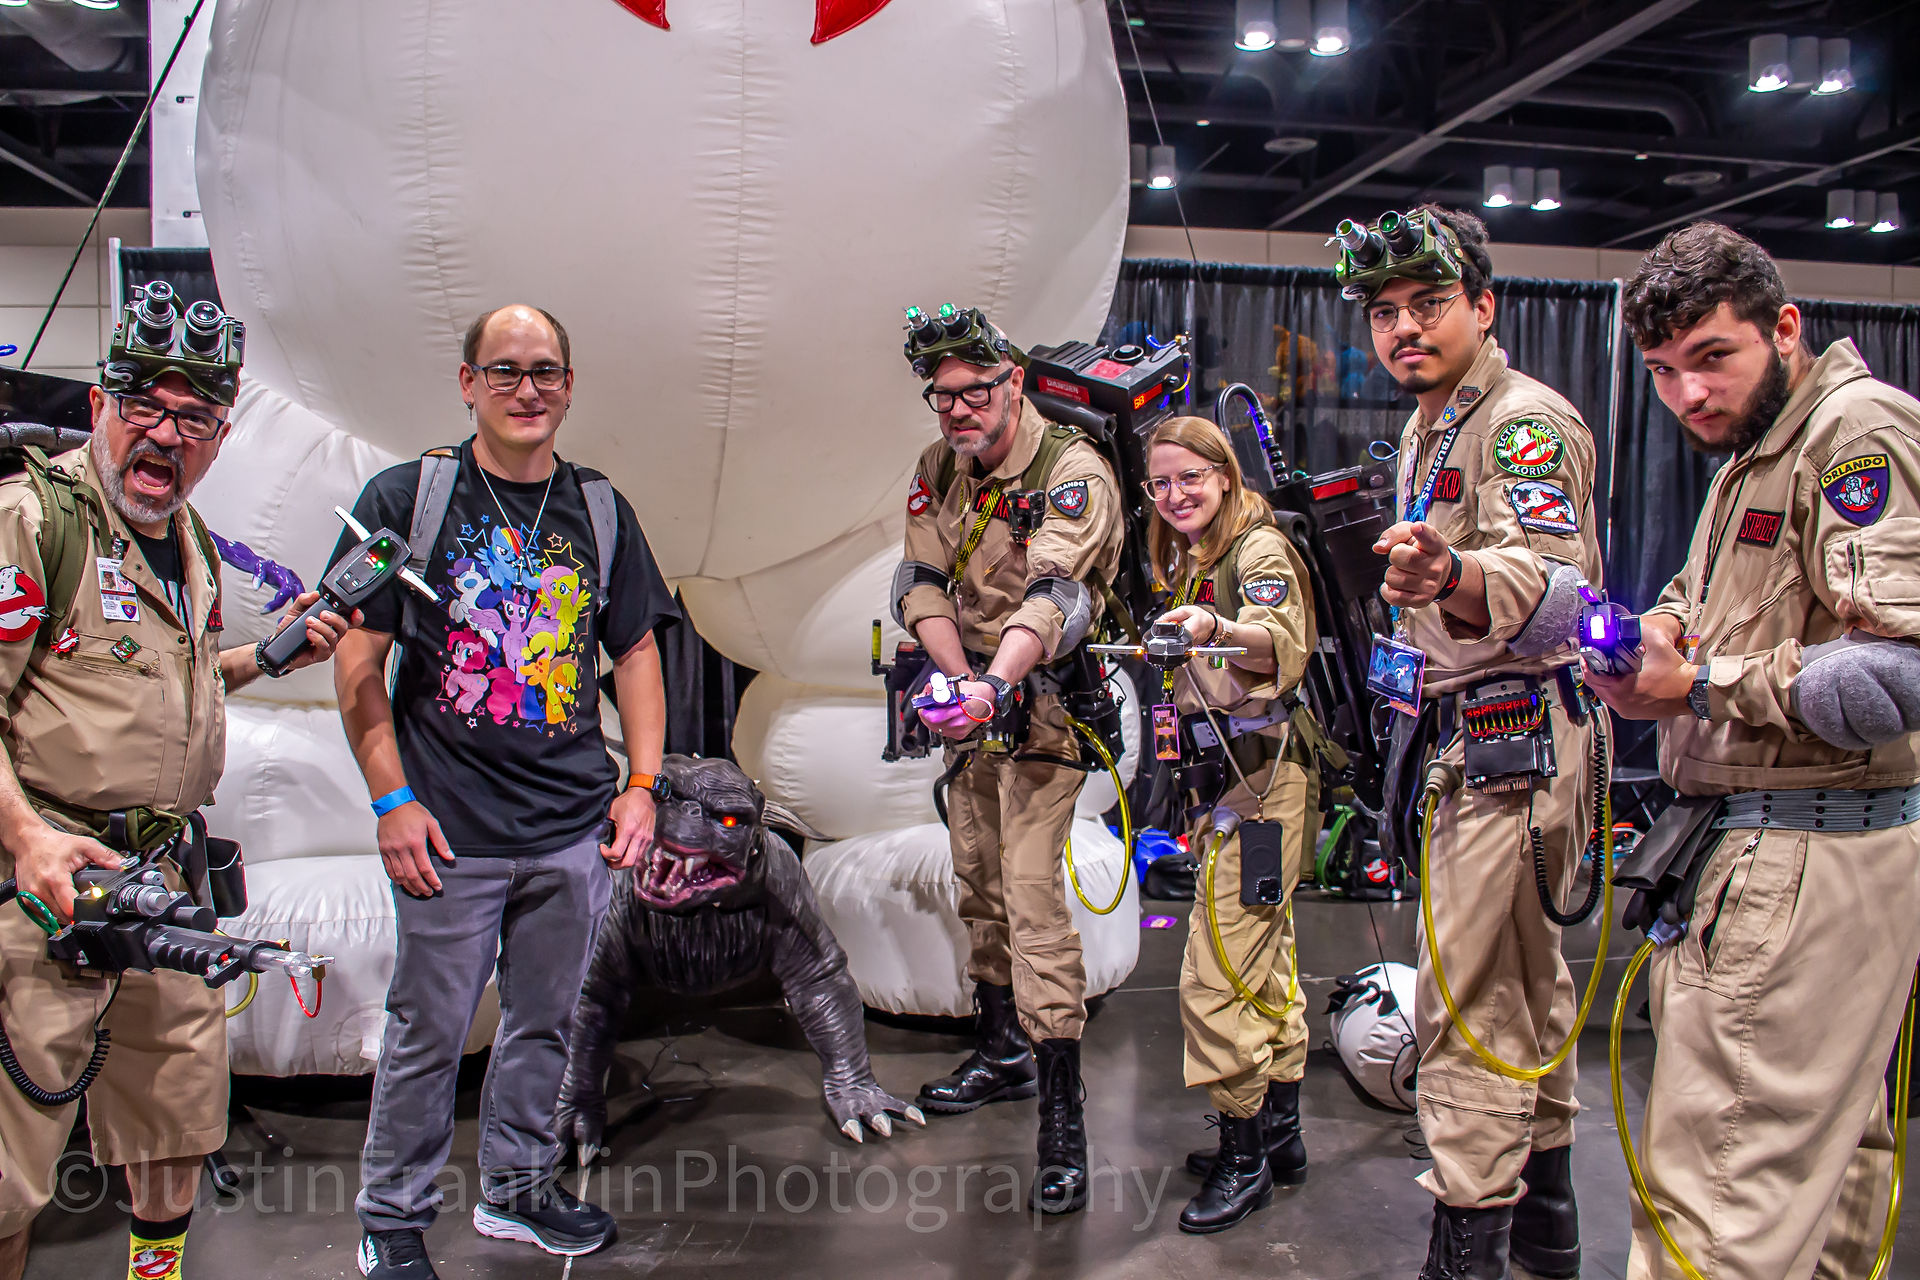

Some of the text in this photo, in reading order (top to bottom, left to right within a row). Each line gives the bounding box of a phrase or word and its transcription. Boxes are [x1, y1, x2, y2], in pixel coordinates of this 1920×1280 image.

[1497, 421, 1561, 447] ECTO FORCE
[1507, 461, 1556, 475] FLORIDA
[1823, 456, 1883, 484] ORLANDO
[1050, 481, 1085, 497] ORLANDO
[1520, 516, 1578, 531] GHOSTBUSTERS
[1740, 512, 1780, 542] STROZE
[1245, 579, 1286, 589] ORLANDO
[365, 1234, 379, 1274] HOKA
